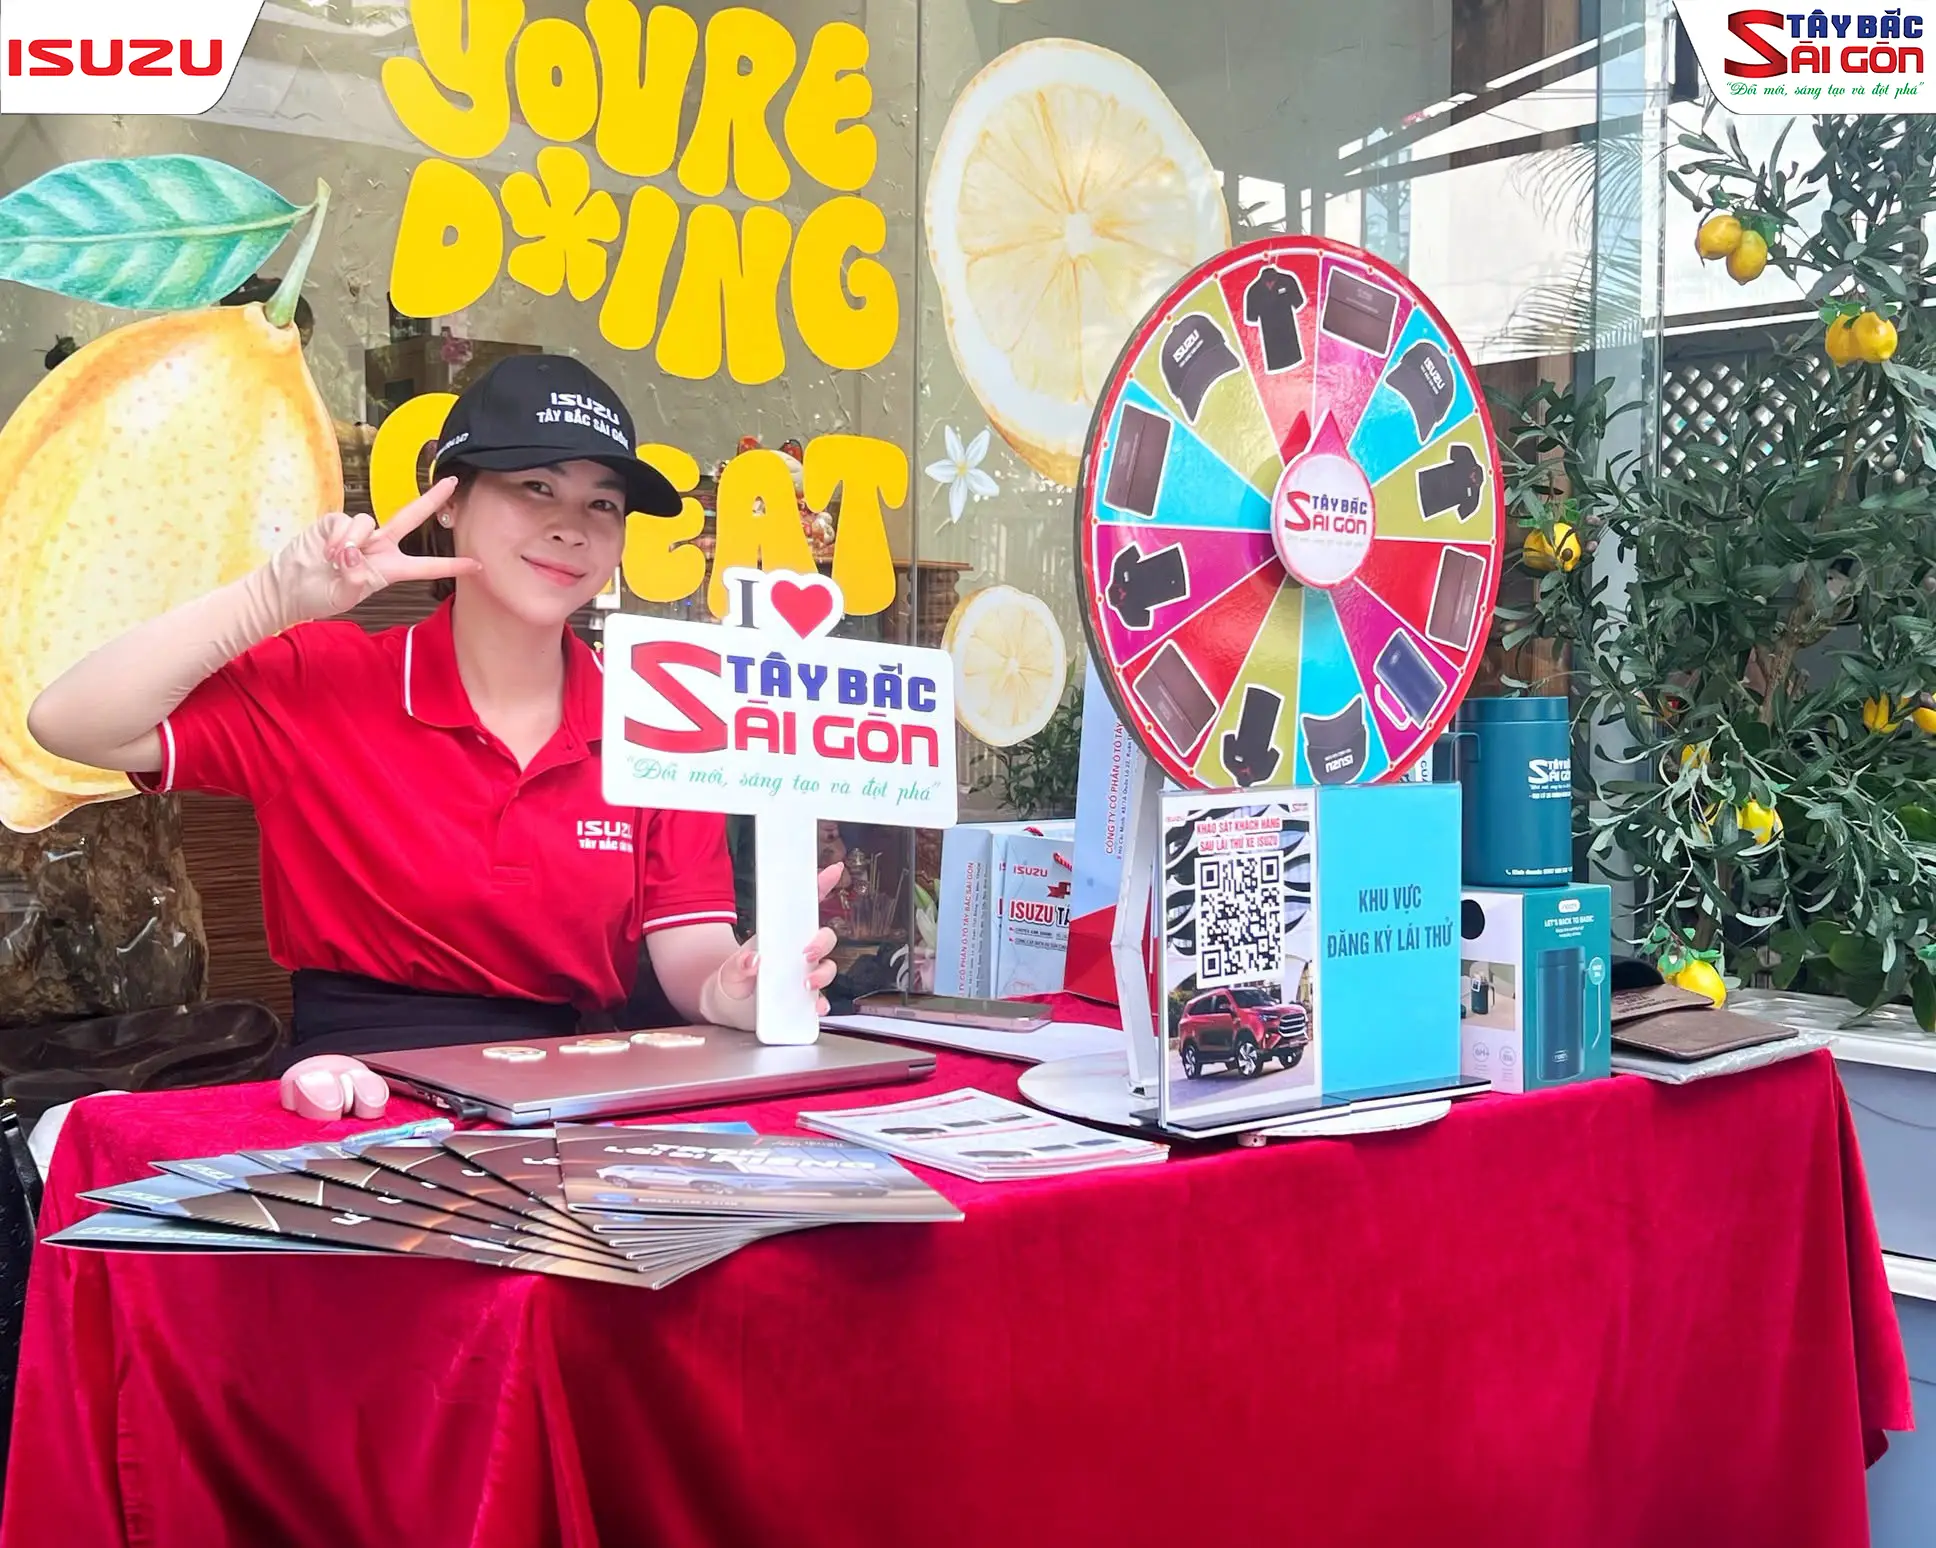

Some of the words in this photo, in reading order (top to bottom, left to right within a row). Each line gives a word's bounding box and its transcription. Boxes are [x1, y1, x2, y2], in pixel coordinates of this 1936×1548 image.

[390, 146, 899, 385] DING
[536, 408, 561, 424] TÂY
[550, 392, 620, 426] ISUZU
[1312, 494, 1339, 511] TÂY
[1341, 497, 1368, 515] BẮC
[737, 578, 760, 629] I
[727, 651, 828, 702] TÂY
[838, 663, 936, 713] BẮC
[739, 771, 781, 796] sáng
[793, 774, 820, 793] tạo
[862, 777, 888, 799] đột
[1013, 865, 1048, 878] ISUZU
[1010, 900, 1054, 924] ISUZU
[1359, 889, 1389, 913] KHU
[1393, 884, 1422, 915] VỰC
[1327, 928, 1370, 959] ĐĂNG
[1374, 924, 1393, 954] KÝ
[1397, 921, 1419, 951] LÁI
[1424, 915, 1453, 949] THỬ
